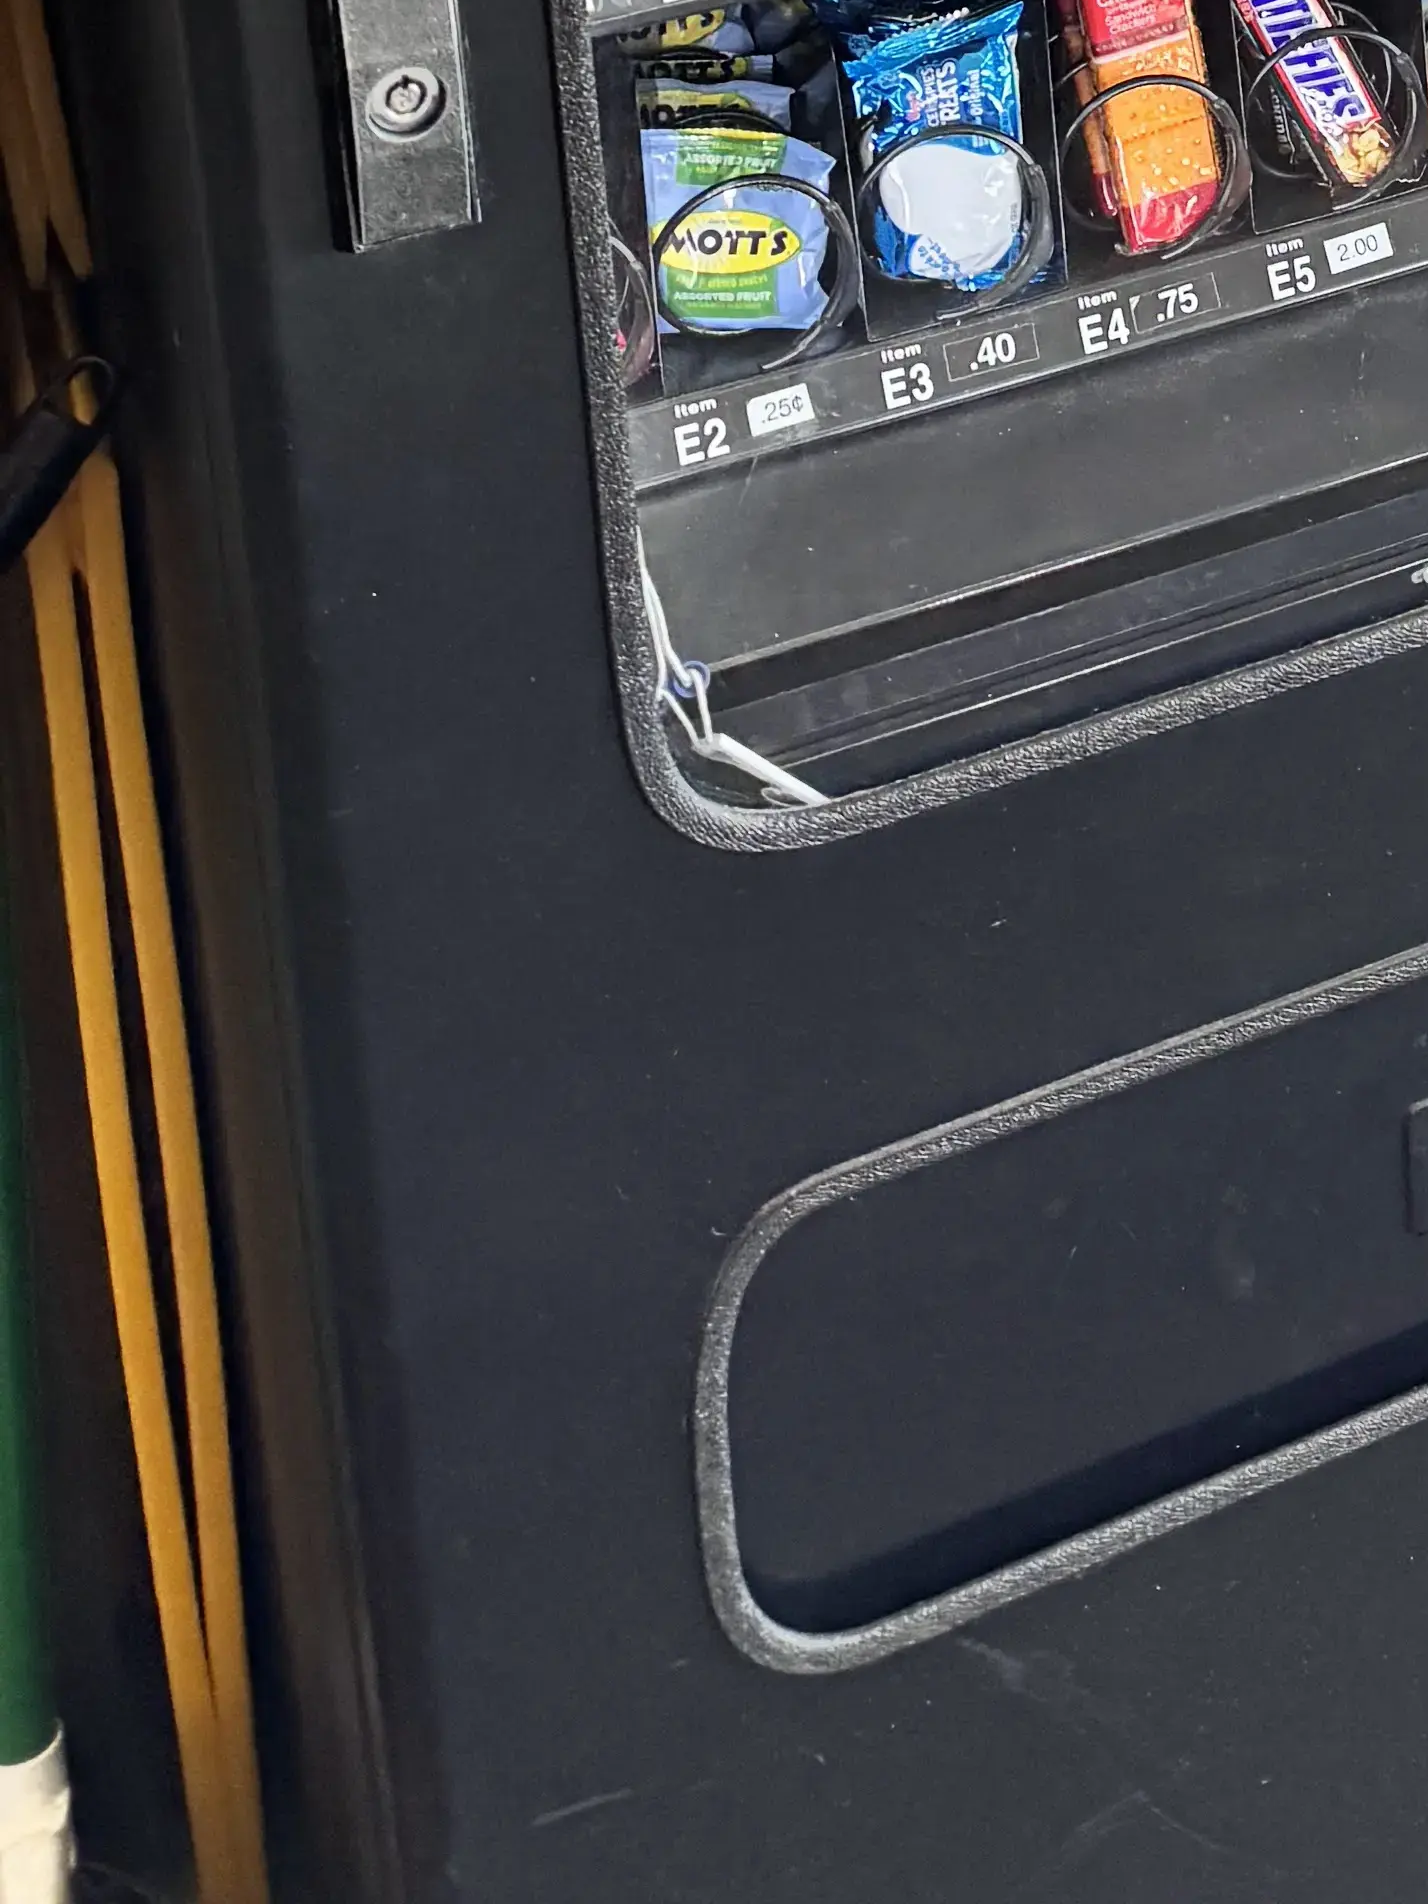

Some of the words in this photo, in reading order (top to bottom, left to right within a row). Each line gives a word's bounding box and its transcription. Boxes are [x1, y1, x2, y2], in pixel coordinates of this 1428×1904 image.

[1337, 235, 1379, 262] 2.00
[1266, 261, 1316, 301] E5
[1156, 283, 1199, 323] .75
[970, 332, 1016, 372] .40
[1077, 311, 1130, 356] E4
[880, 366, 935, 410] E3
[673, 421, 730, 467] E2
